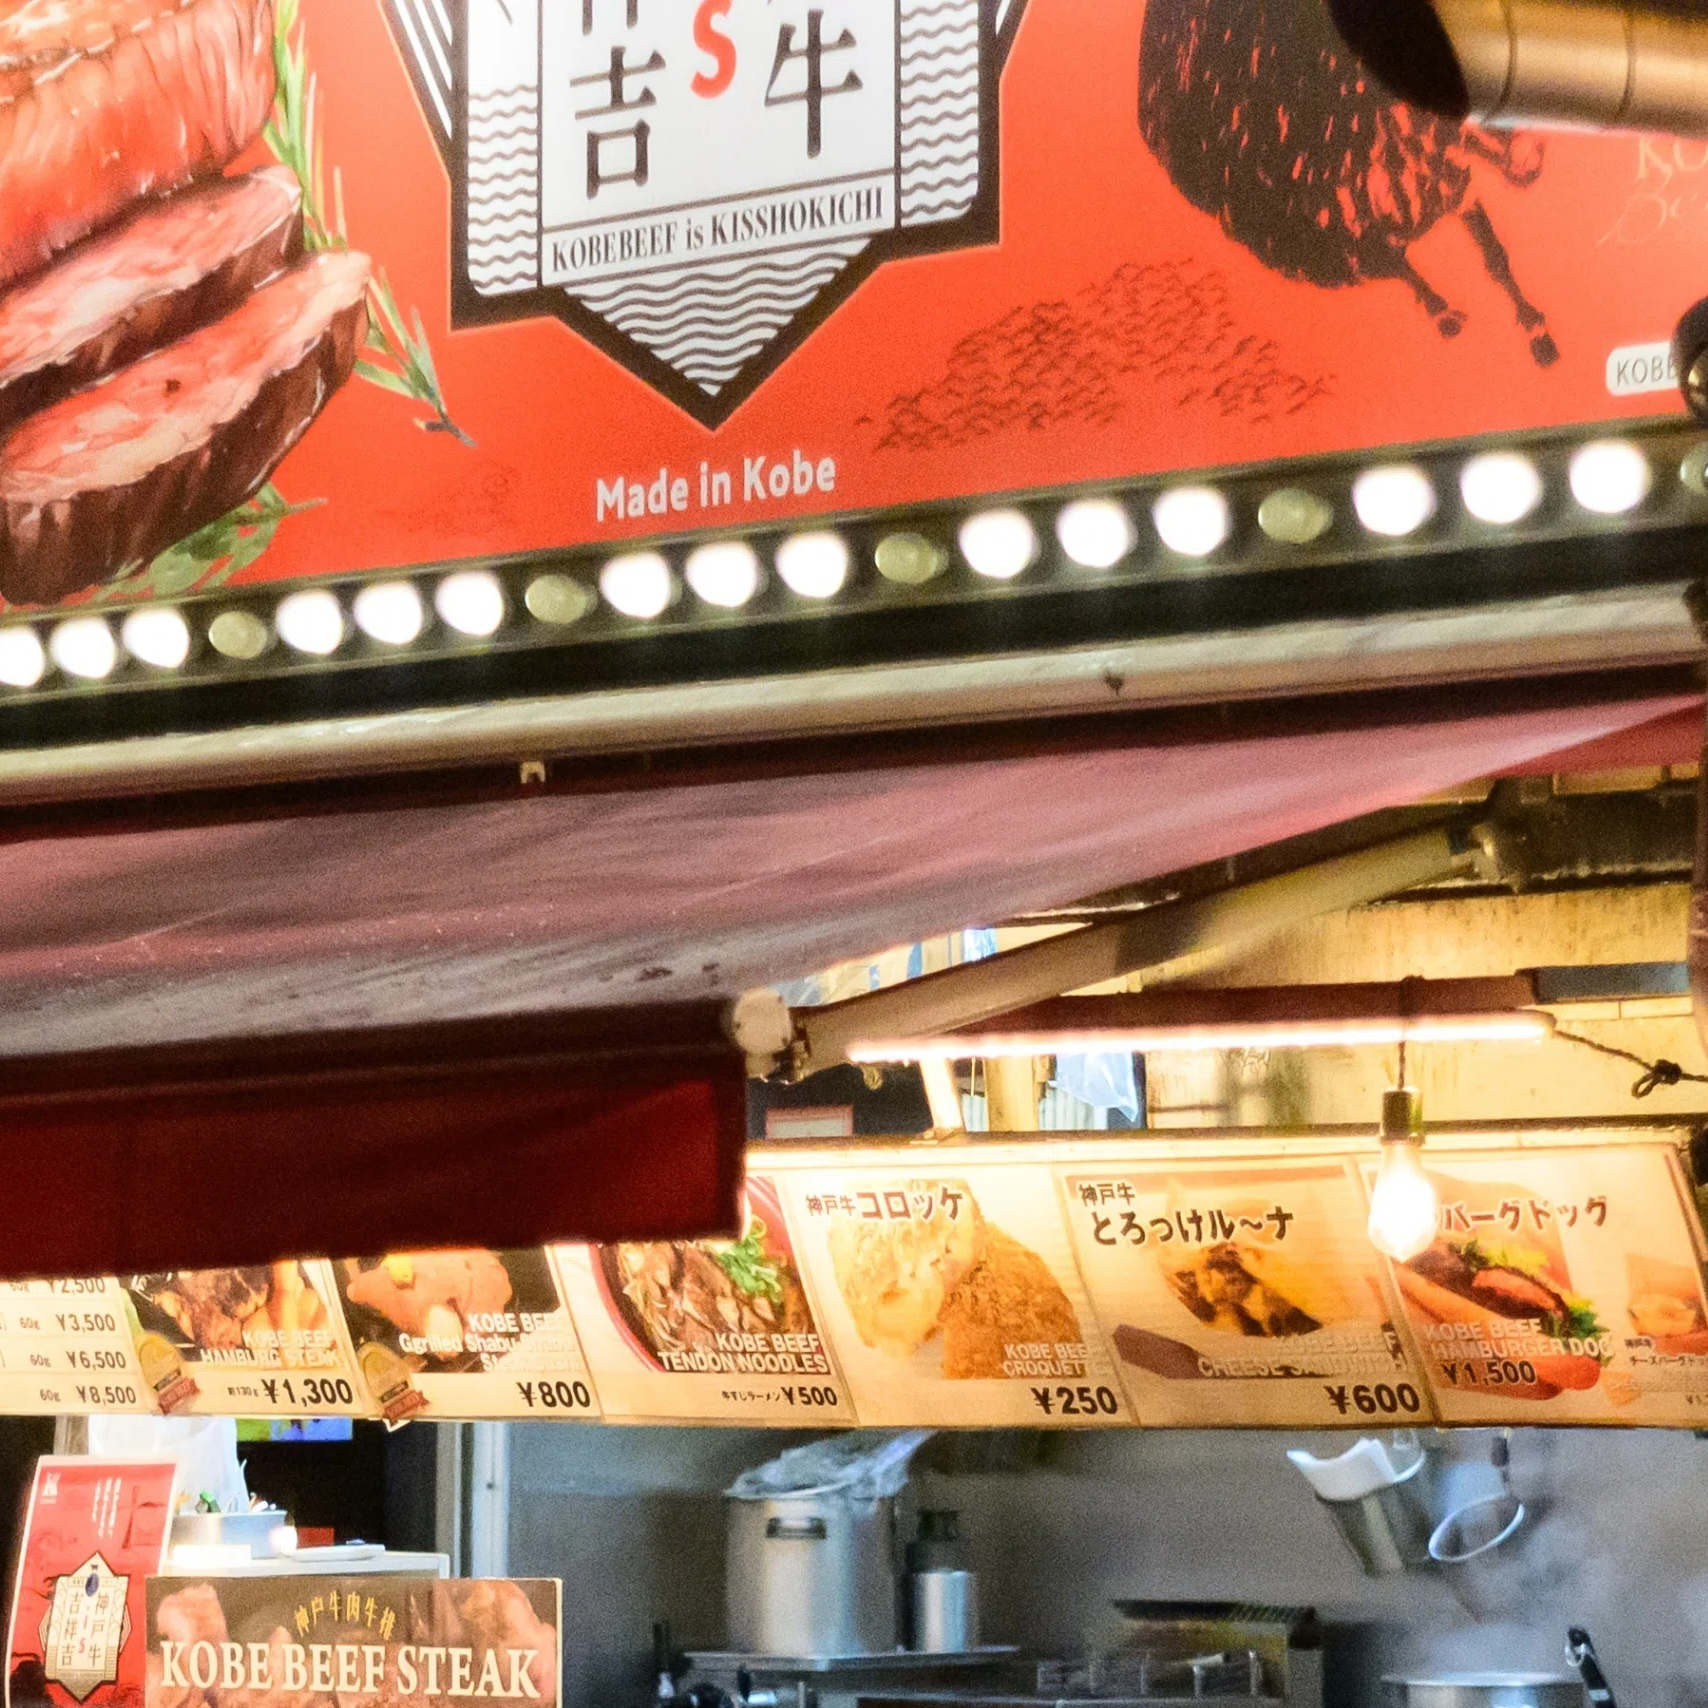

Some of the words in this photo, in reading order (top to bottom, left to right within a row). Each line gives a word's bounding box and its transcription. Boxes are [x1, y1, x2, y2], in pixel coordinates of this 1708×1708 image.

[551, 221, 679, 274] KOBEBEEF
[686, 222, 705, 250] is
[710, 186, 885, 246] KISSHOKICHI
[595, 474, 689, 522] Made
[698, 465, 733, 508] in
[742, 451, 837, 504] Kobe
[1078, 1182, 1135, 1207] 神戸牛
[56, 1313, 116, 1334] ¥3,500
[467, 1313, 518, 1332] KOBE
[1426, 1323, 1486, 1340] KOBE
[1489, 1320, 1543, 1337] BEEF
[243, 1330, 291, 1348] KOBE
[715, 1334, 769, 1352] KOBE
[772, 1334, 820, 1352] BEEF
[66, 1350, 127, 1370] ¥6,500
[200, 1349, 282, 1366] HAMBURG
[658, 1351, 738, 1371] TENDON
[741, 1353, 829, 1373] NOODLES
[1004, 1343, 1053, 1359] KOBE
[1443, 1361, 1537, 1386] ¥1,500
[76, 1386, 137, 1405] ¥8,500
[261, 1378, 354, 1407] ¥1,300
[516, 1381, 591, 1408] ¥800
[781, 1386, 838, 1406] ¥500
[1031, 1386, 1118, 1415] ¥250
[1324, 1383, 1420, 1415] ¥600
[88, 1592, 110, 1667] 神戸牛
[161, 1641, 274, 1689] KOBE
[282, 1644, 386, 1693] BEEF
[396, 1645, 541, 1698] STEAK
